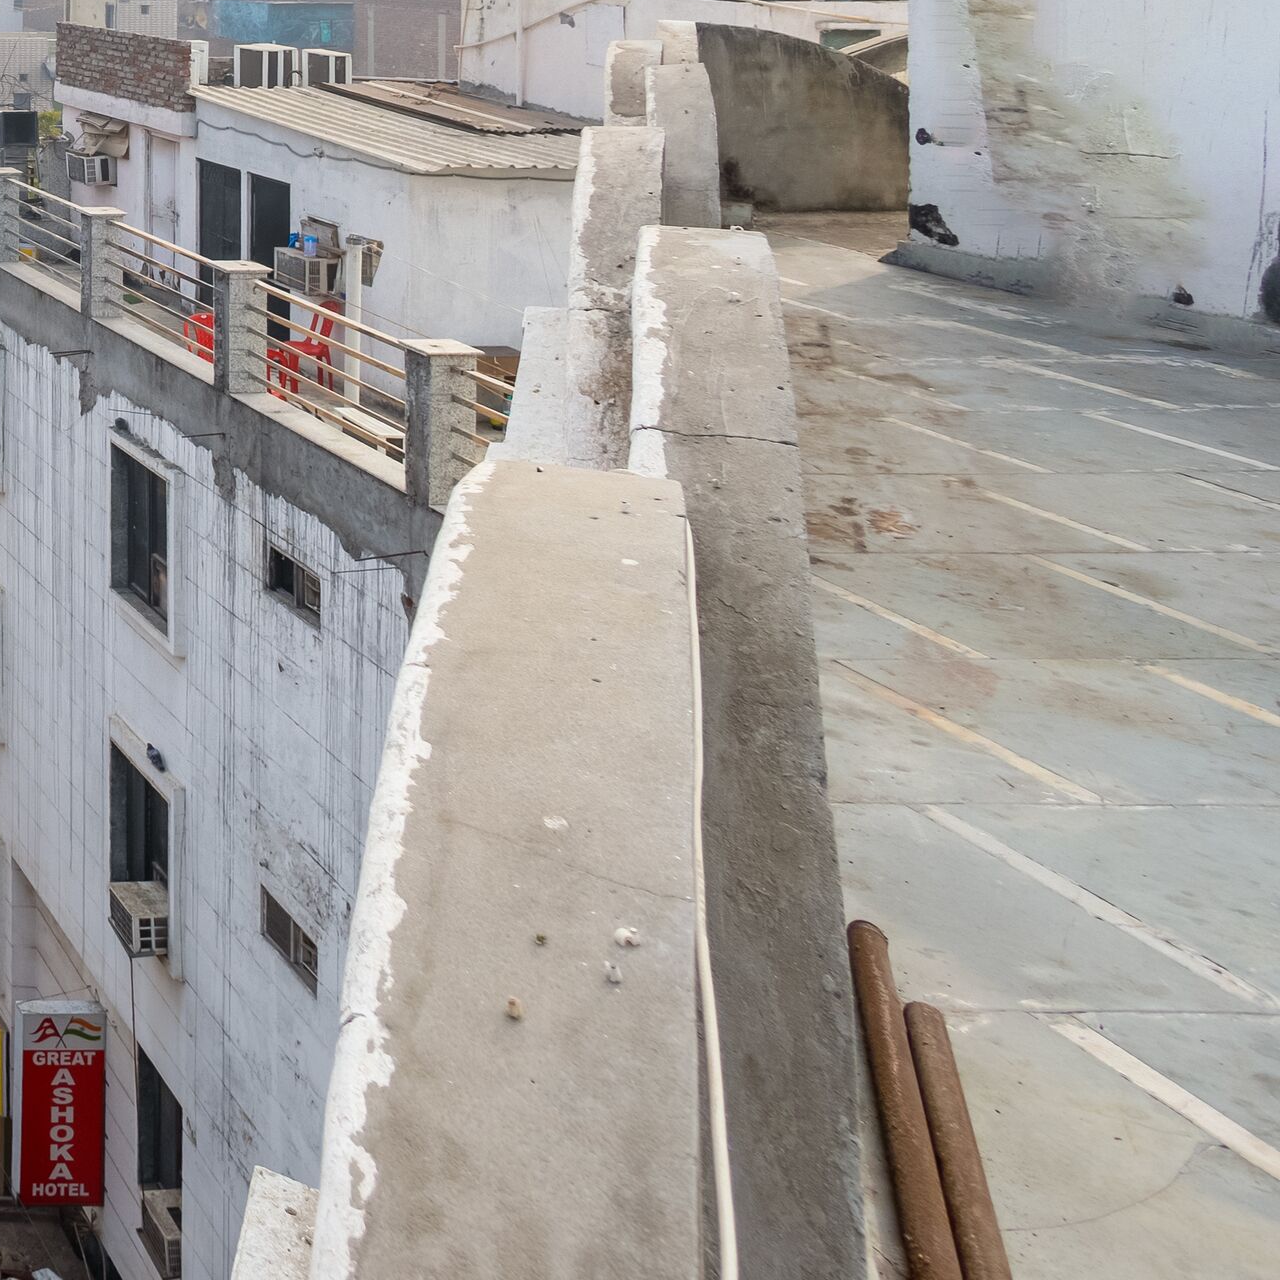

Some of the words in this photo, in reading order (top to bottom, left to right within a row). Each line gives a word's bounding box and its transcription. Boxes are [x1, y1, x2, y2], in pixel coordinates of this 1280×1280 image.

[32, 1052, 96, 1066] GREAT
[48, 1068, 76, 1180] ASHOKA
[32, 1183, 90, 1197] HOTEL
